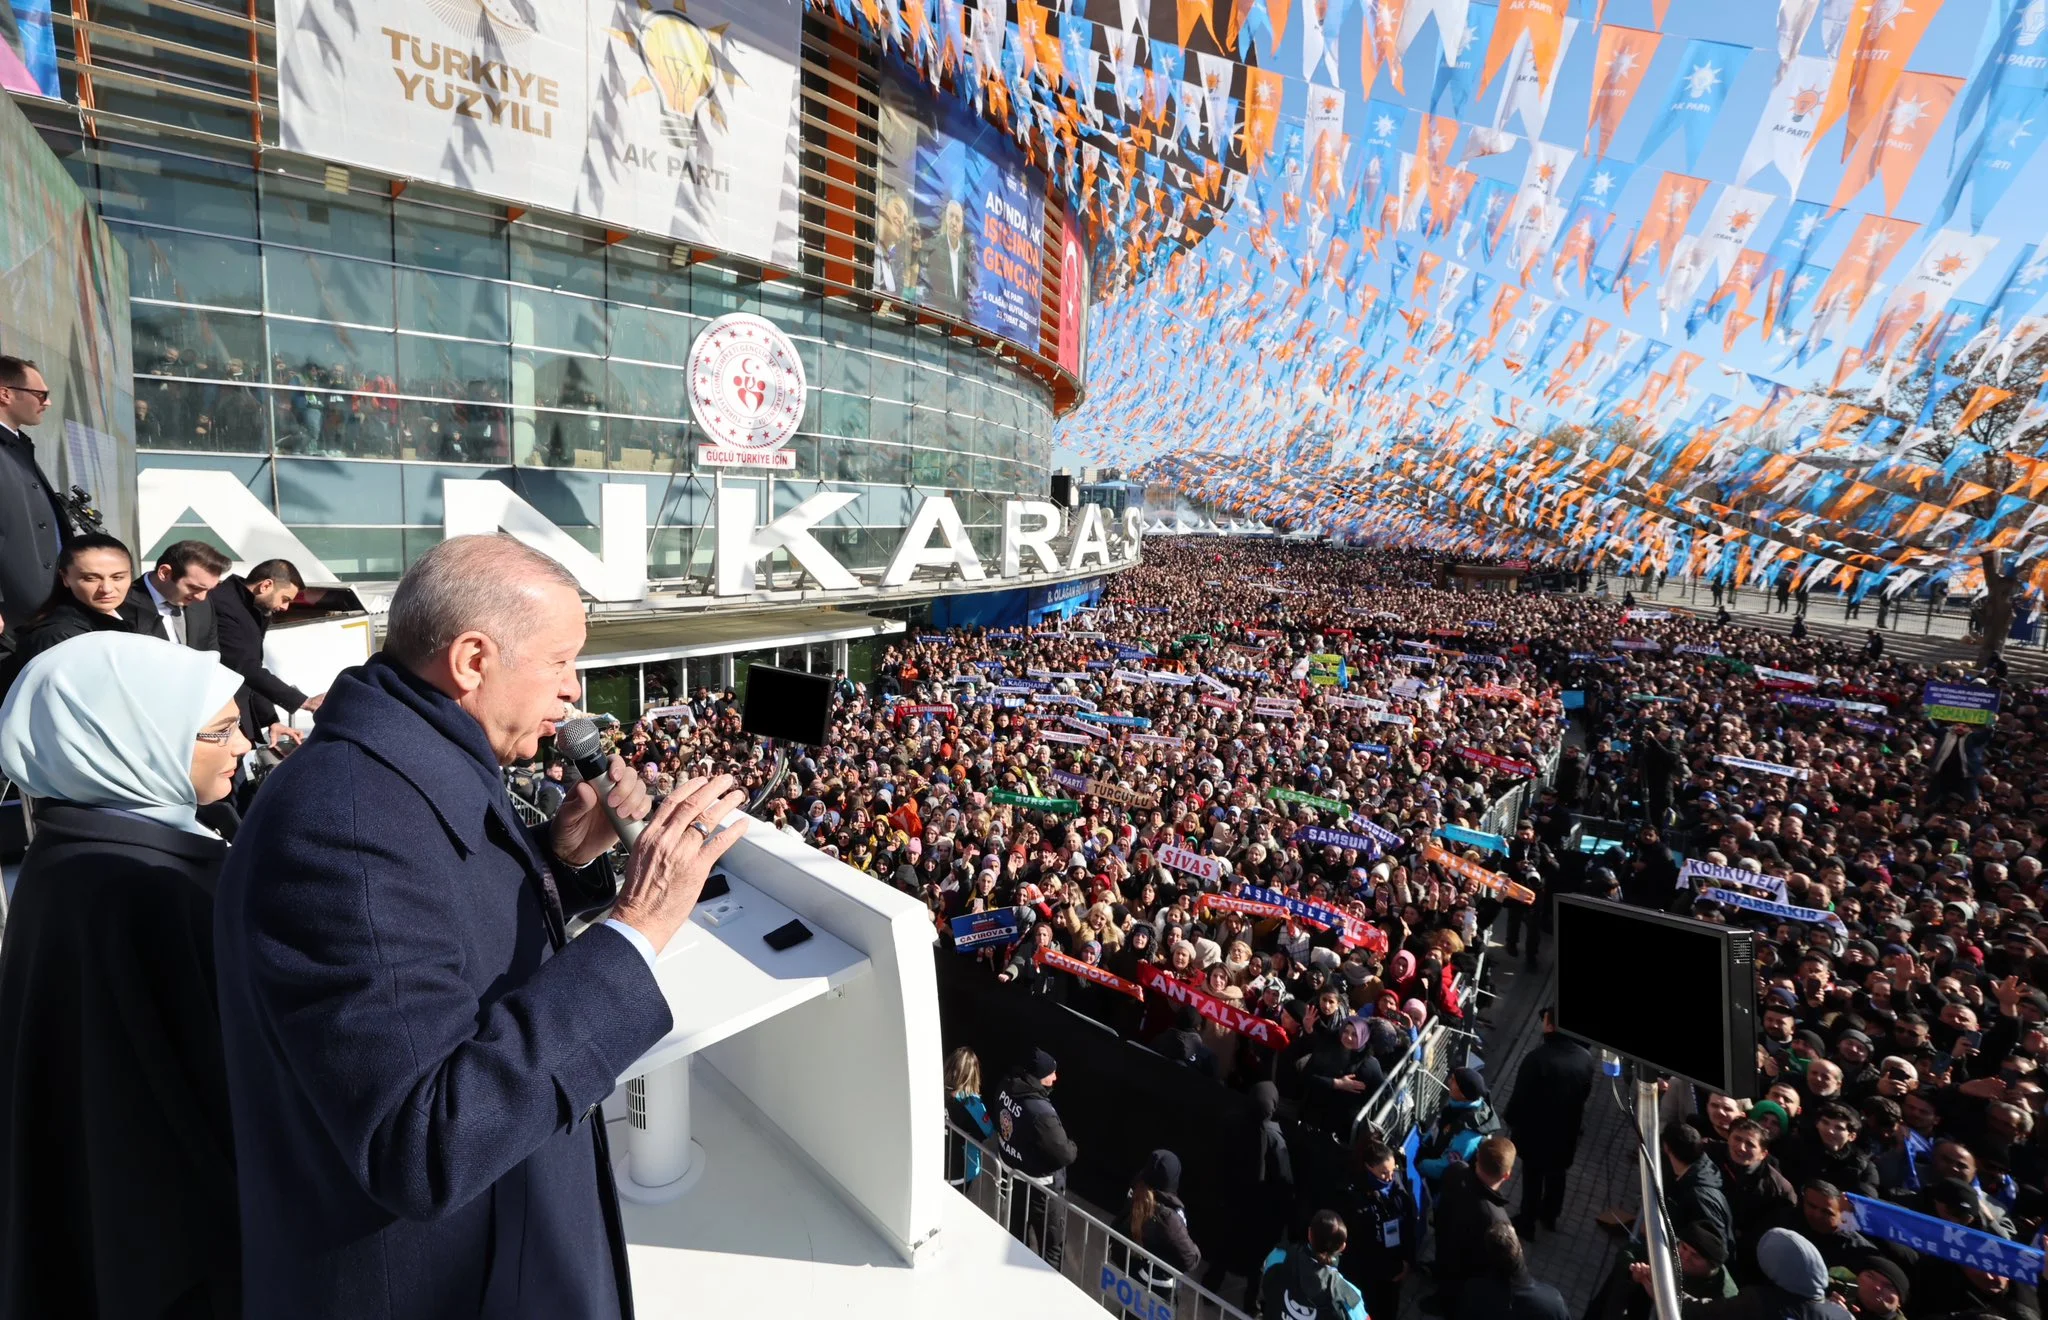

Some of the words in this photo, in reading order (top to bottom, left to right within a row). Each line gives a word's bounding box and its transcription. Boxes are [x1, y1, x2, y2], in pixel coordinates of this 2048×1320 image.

[381, 26, 560, 108] TÜRKİYE
[393, 66, 552, 139] YÜZYILI
[623, 143, 658, 173] AK
[667, 155, 730, 193] PARTİ
[983, 246, 1039, 299] GENÇLİK
[706, 450, 734, 464] GÜÇLÜ
[736, 452, 770, 464] TÜRKİYE
[772, 452, 788, 466] İÇİN
[1467, 653, 1497, 664] İZMİR
[1052, 773, 1063, 783] AK
[1063, 775, 1083, 790] PARTİ
[1094, 783, 1149, 808] TURGUTLU
[1015, 795, 1052, 807] BURSA
[1308, 829, 1368, 850] SAMSUN
[1163, 850, 1212, 877] SİVAS
[1439, 852, 1504, 887] ALANYA
[1690, 860, 1783, 892] KORKUTELİ
[1151, 974, 1268, 1041] ANTALYA
[999, 1090, 1023, 1118] POLİS
